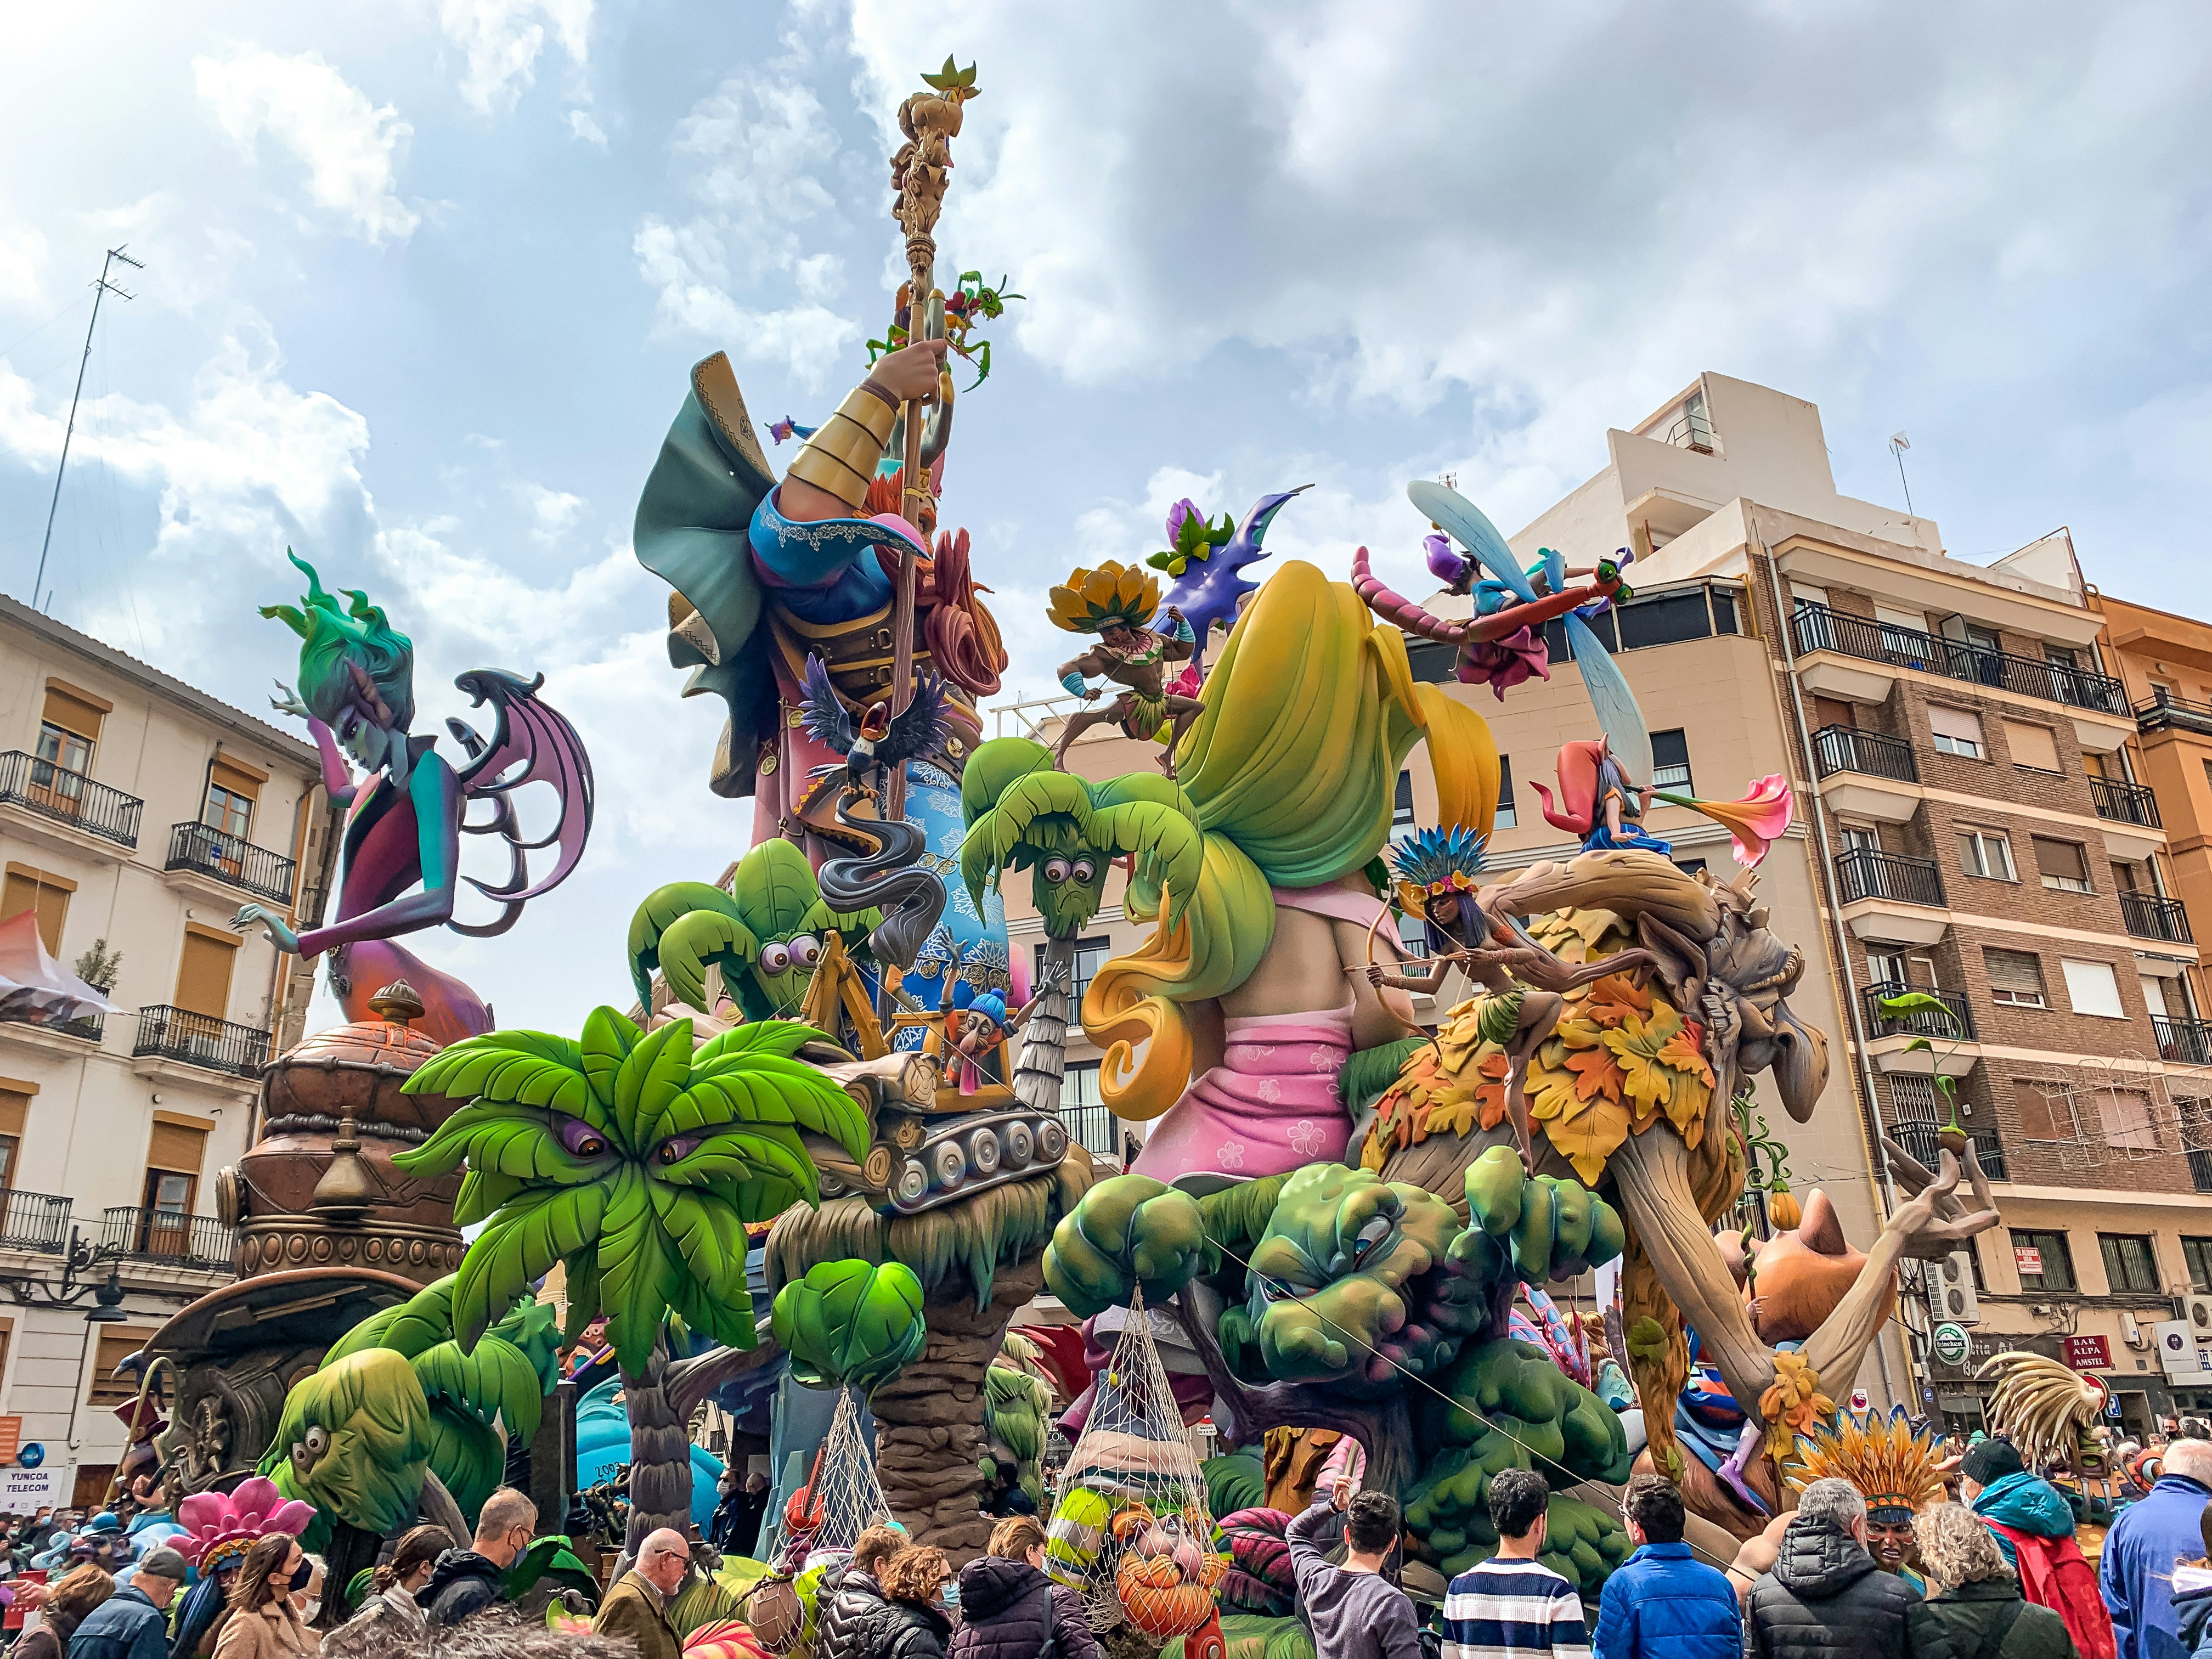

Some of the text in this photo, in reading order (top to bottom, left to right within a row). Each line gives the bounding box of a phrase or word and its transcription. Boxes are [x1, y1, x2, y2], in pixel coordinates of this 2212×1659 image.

[2076, 1358, 2104, 1367] AMSTEL
[11, 1472, 48, 1481] YUNCOA
[6, 1484, 49, 1492] TELECOM
